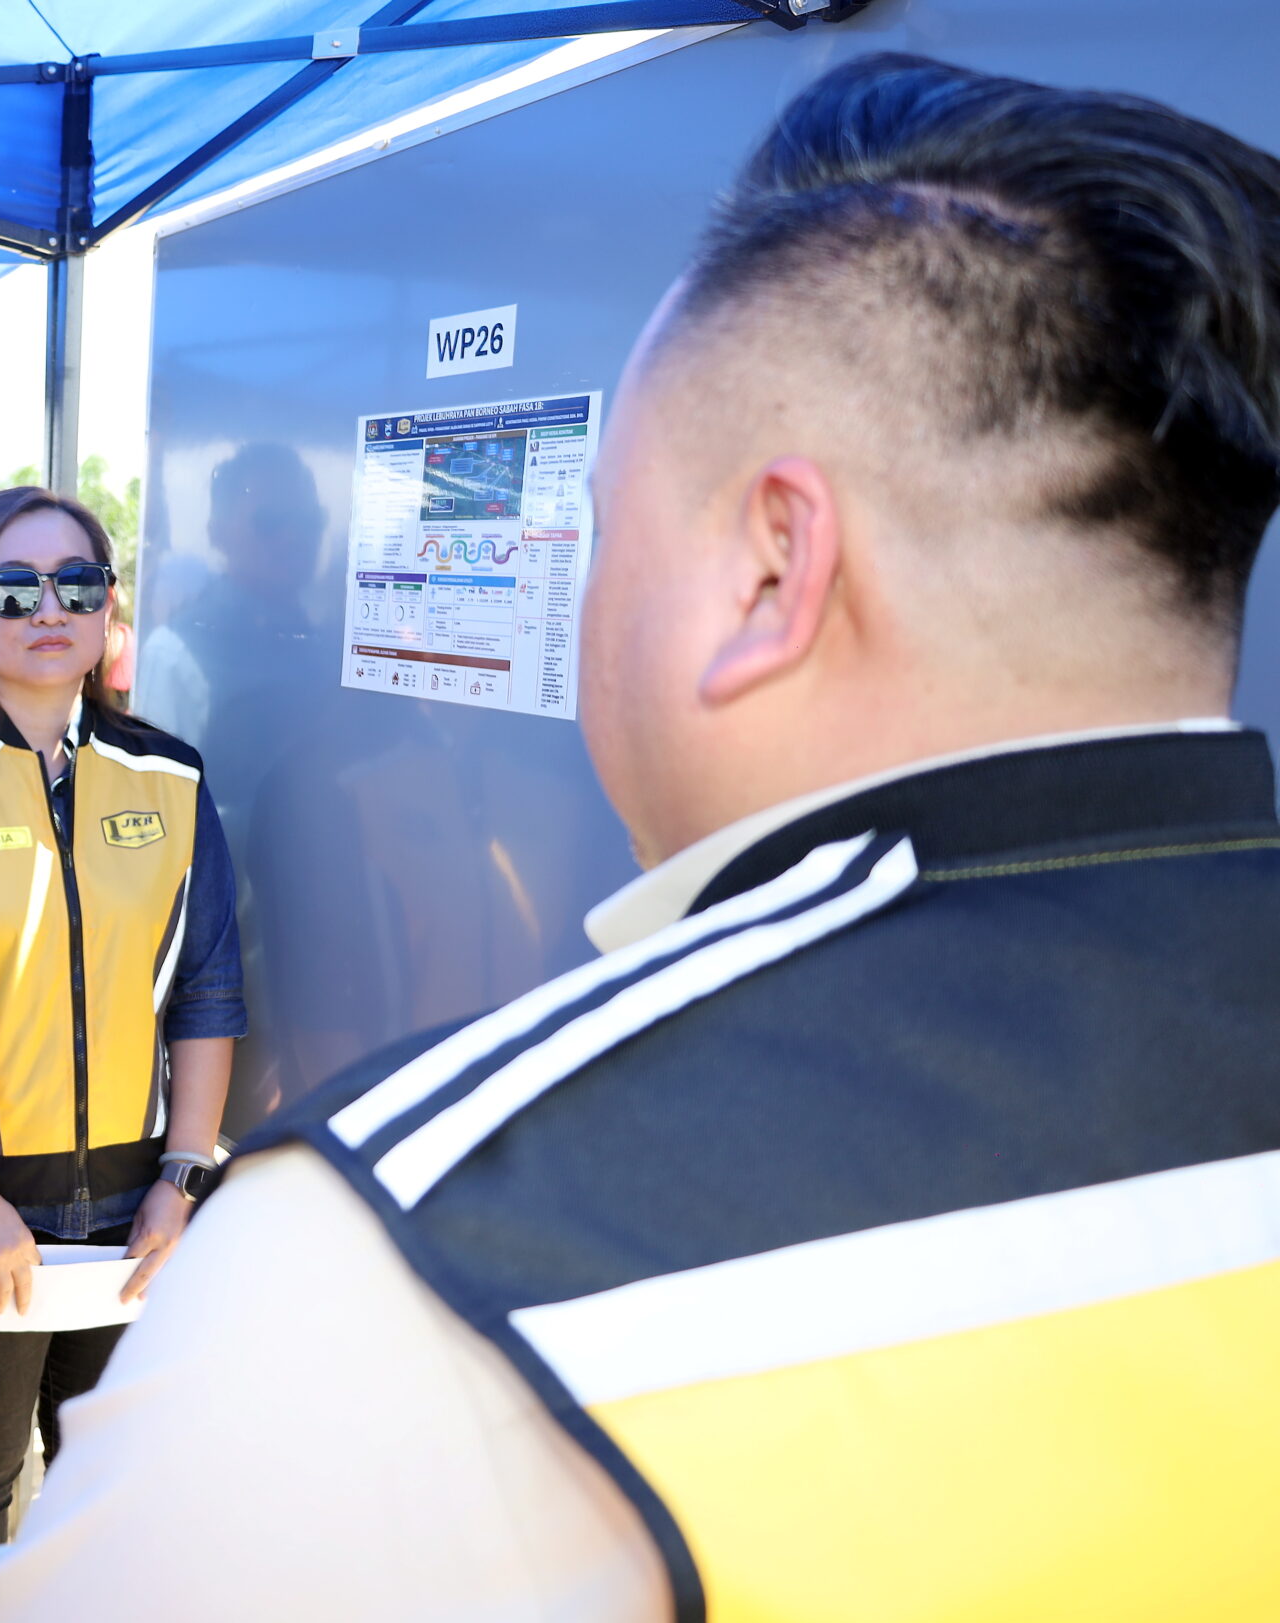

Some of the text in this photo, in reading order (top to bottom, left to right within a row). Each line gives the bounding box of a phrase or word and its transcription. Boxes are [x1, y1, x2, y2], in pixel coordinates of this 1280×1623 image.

[436, 322, 504, 363] WP26
[464, 408, 476, 419] PAN
[476, 406, 499, 418] BORNEO
[499, 403, 519, 415] SABAH
[519, 401, 534, 413] FASA
[122, 815, 153, 829] JKR
